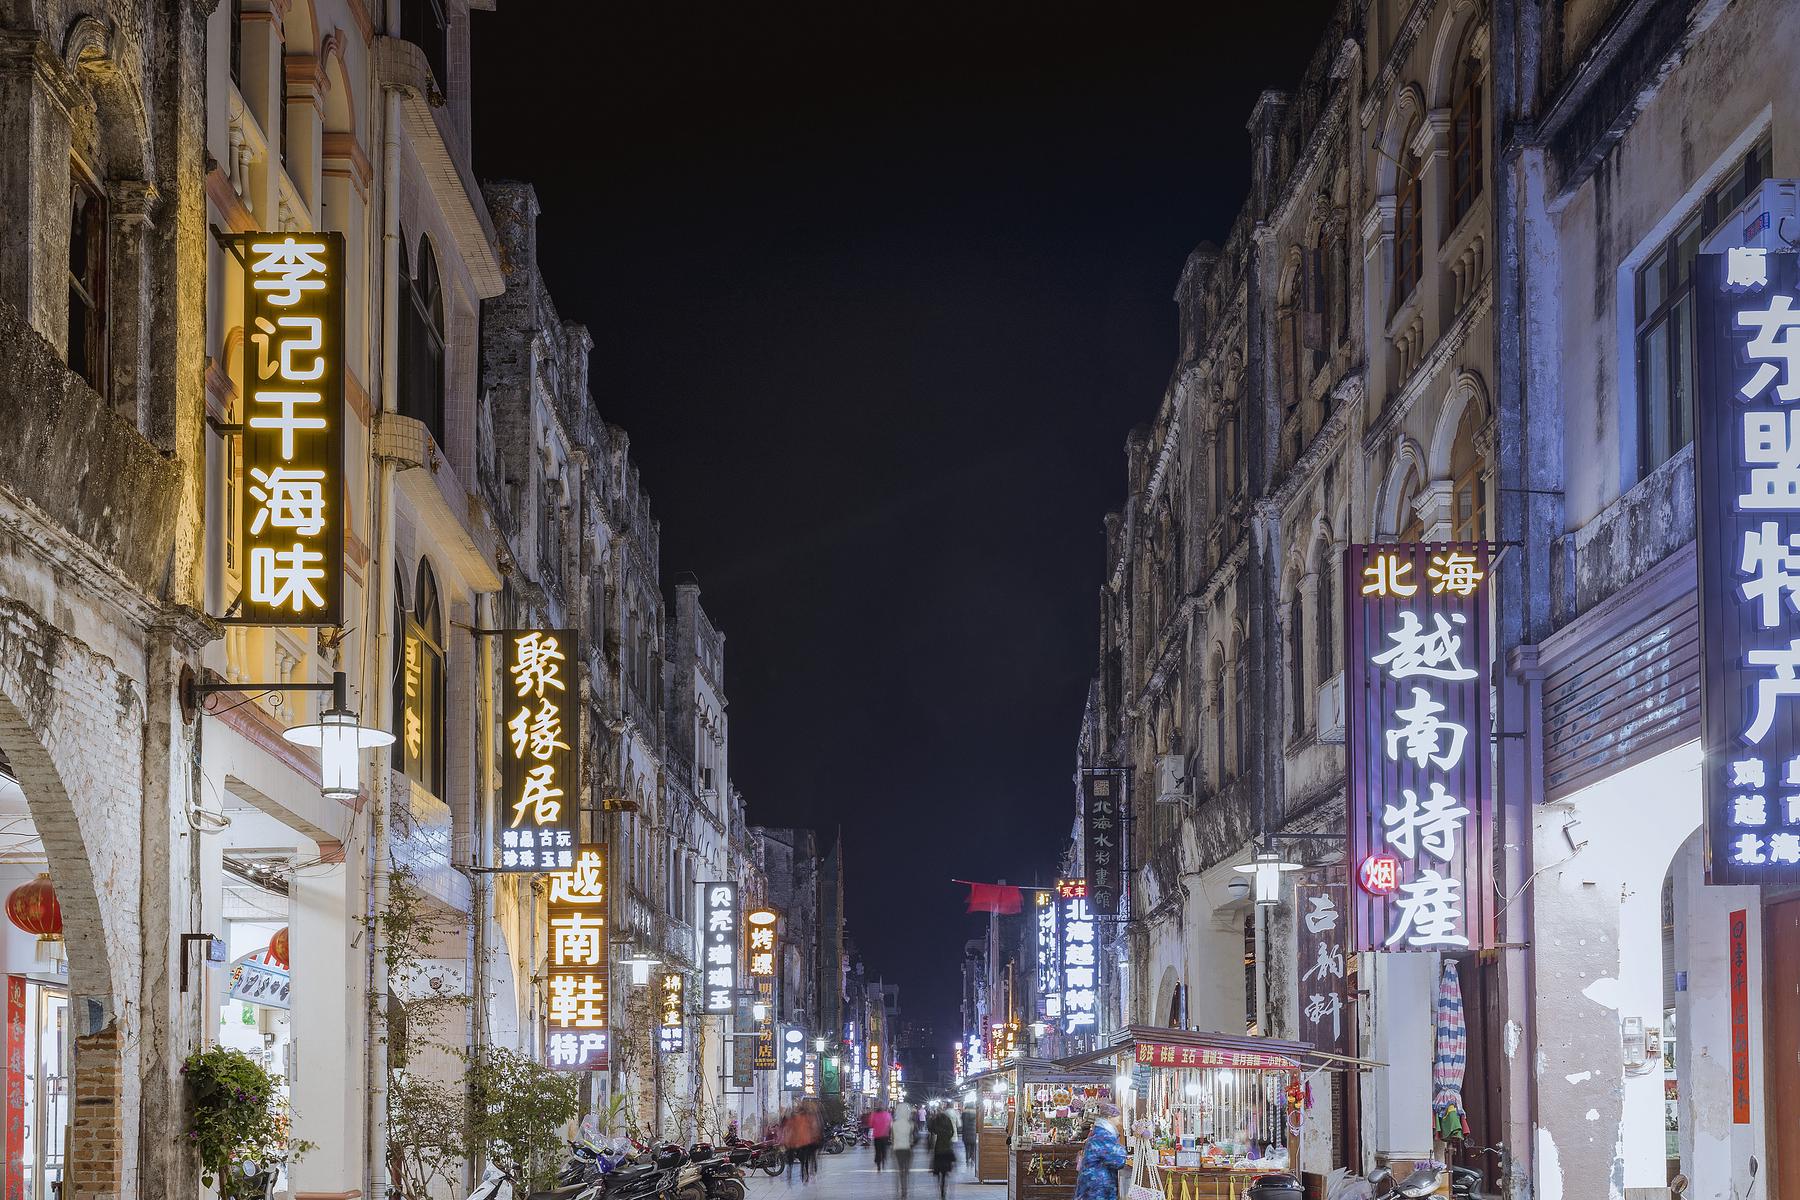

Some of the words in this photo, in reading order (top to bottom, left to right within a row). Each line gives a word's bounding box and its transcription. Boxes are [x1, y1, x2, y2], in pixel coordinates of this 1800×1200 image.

[249, 237, 327, 612] 李记干海味
[1361, 553, 1484, 596] 北海
[507, 631, 571, 828] 聚缘居
[1366, 857, 1397, 890] 烟
[550, 851, 604, 1028] 越南鞋
[751, 927, 774, 975] 烤螺
[1065, 899, 1095, 1035] 北海越南特产
[550, 1033, 606, 1066] 特产
[785, 1046, 804, 1088] 烤螺
